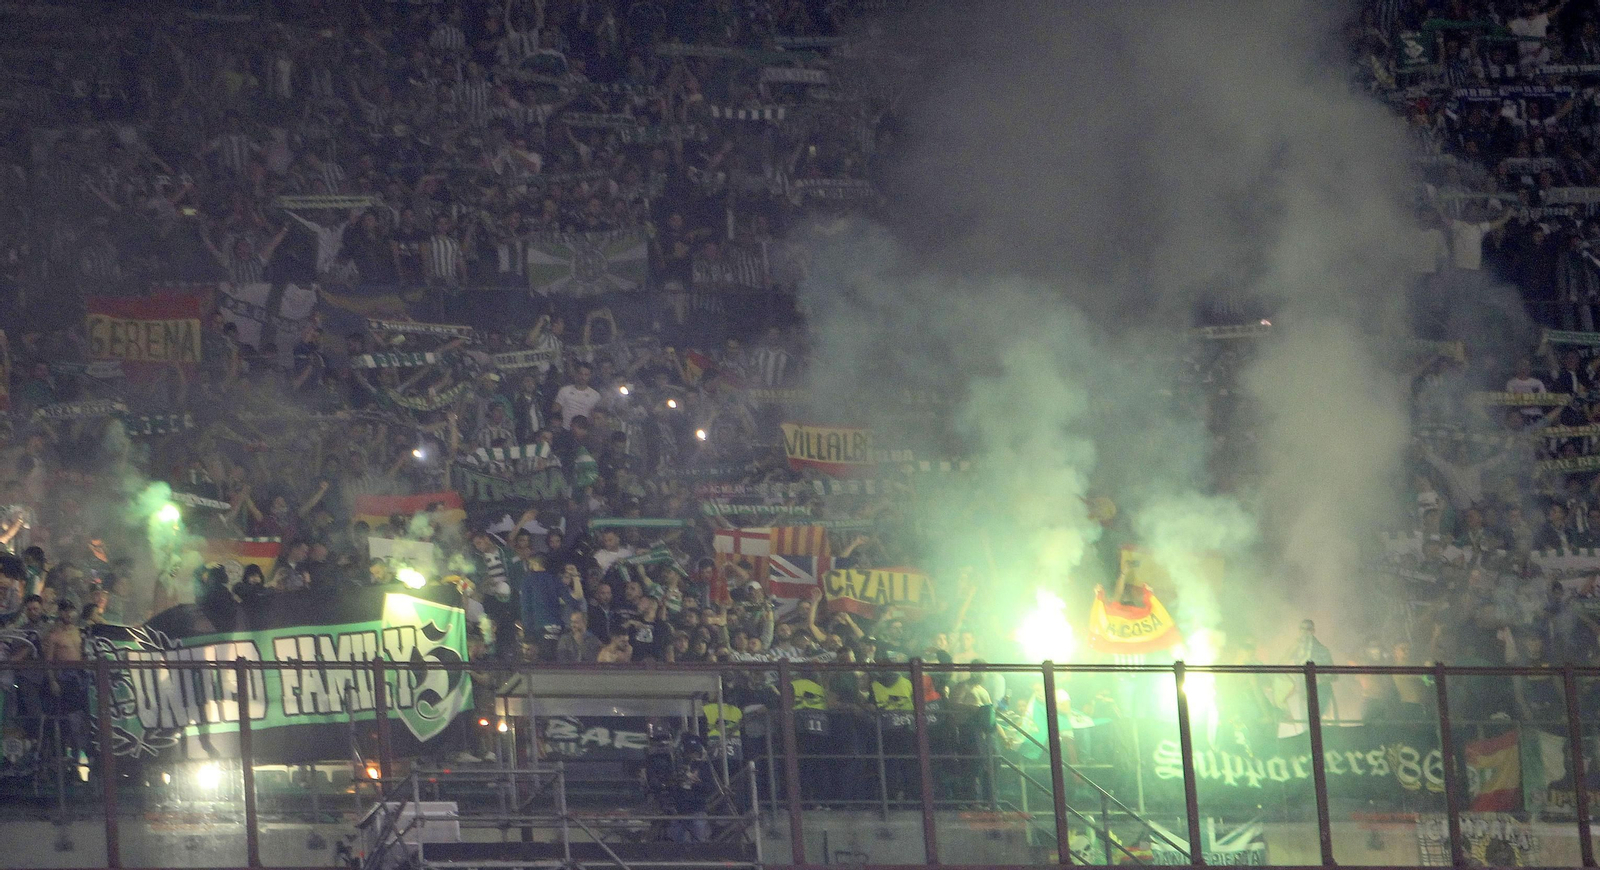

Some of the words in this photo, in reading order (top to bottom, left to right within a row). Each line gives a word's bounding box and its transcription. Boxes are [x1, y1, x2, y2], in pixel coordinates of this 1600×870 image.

[825, 569, 934, 606] CAZALLA
[127, 641, 268, 729] UNITED
[1153, 739, 1388, 788] Supporers
